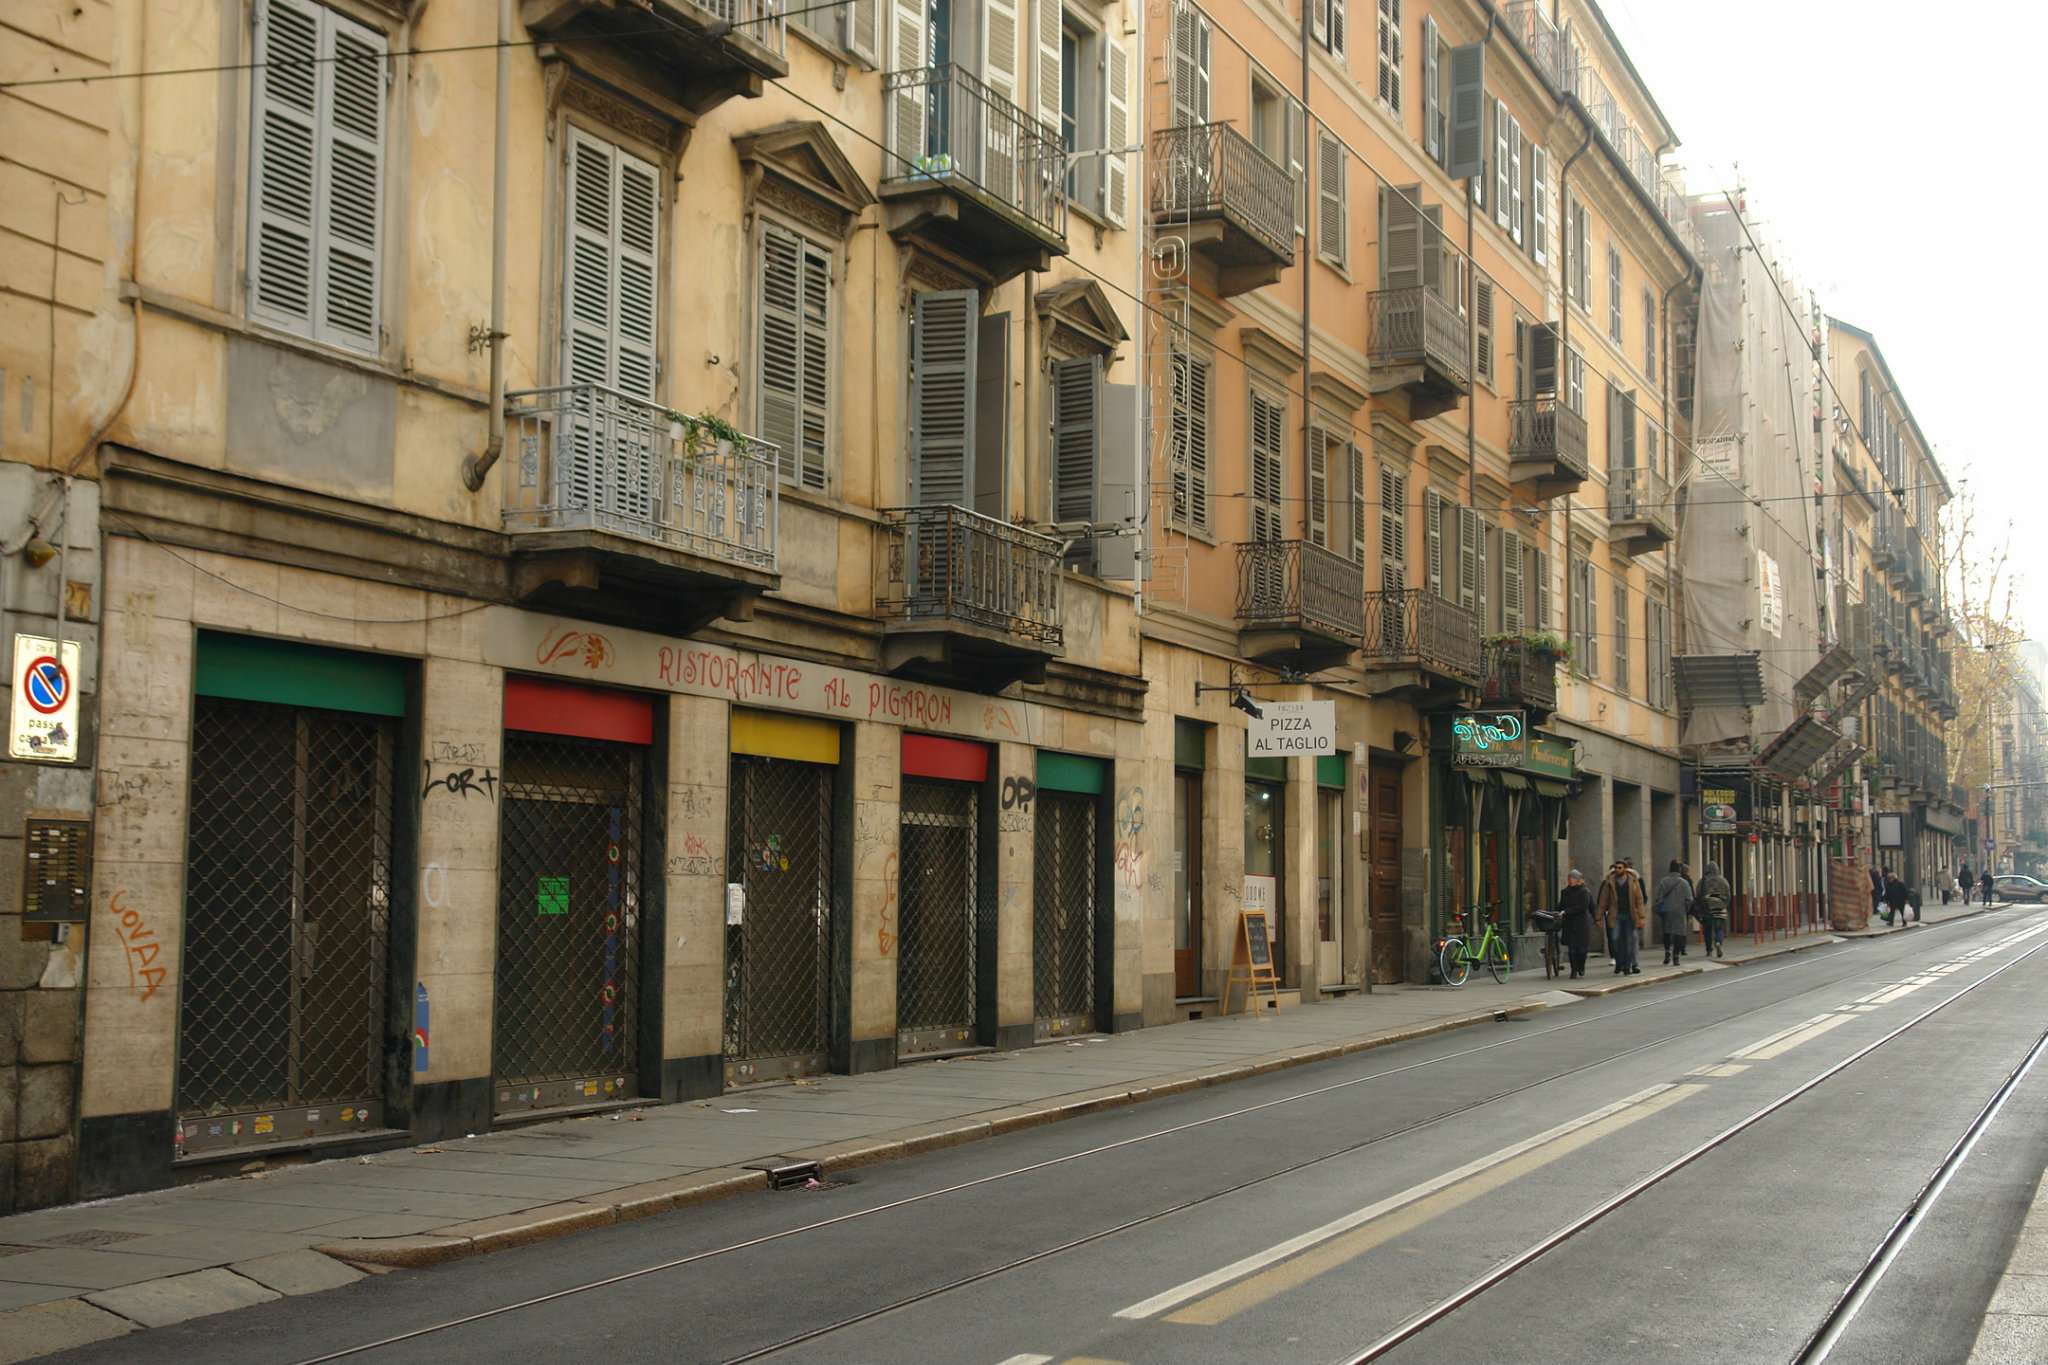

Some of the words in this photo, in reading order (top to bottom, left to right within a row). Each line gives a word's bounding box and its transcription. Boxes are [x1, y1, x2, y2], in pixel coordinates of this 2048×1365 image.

[659, 646, 802, 700] RISTORANTE
[824, 678, 850, 710] AL
[868, 683, 951, 724] PIGARON
[1270, 718, 1312, 731] PIZZA
[1255, 738, 1273, 750] AL
[1276, 736, 1328, 750] TAGLIO
